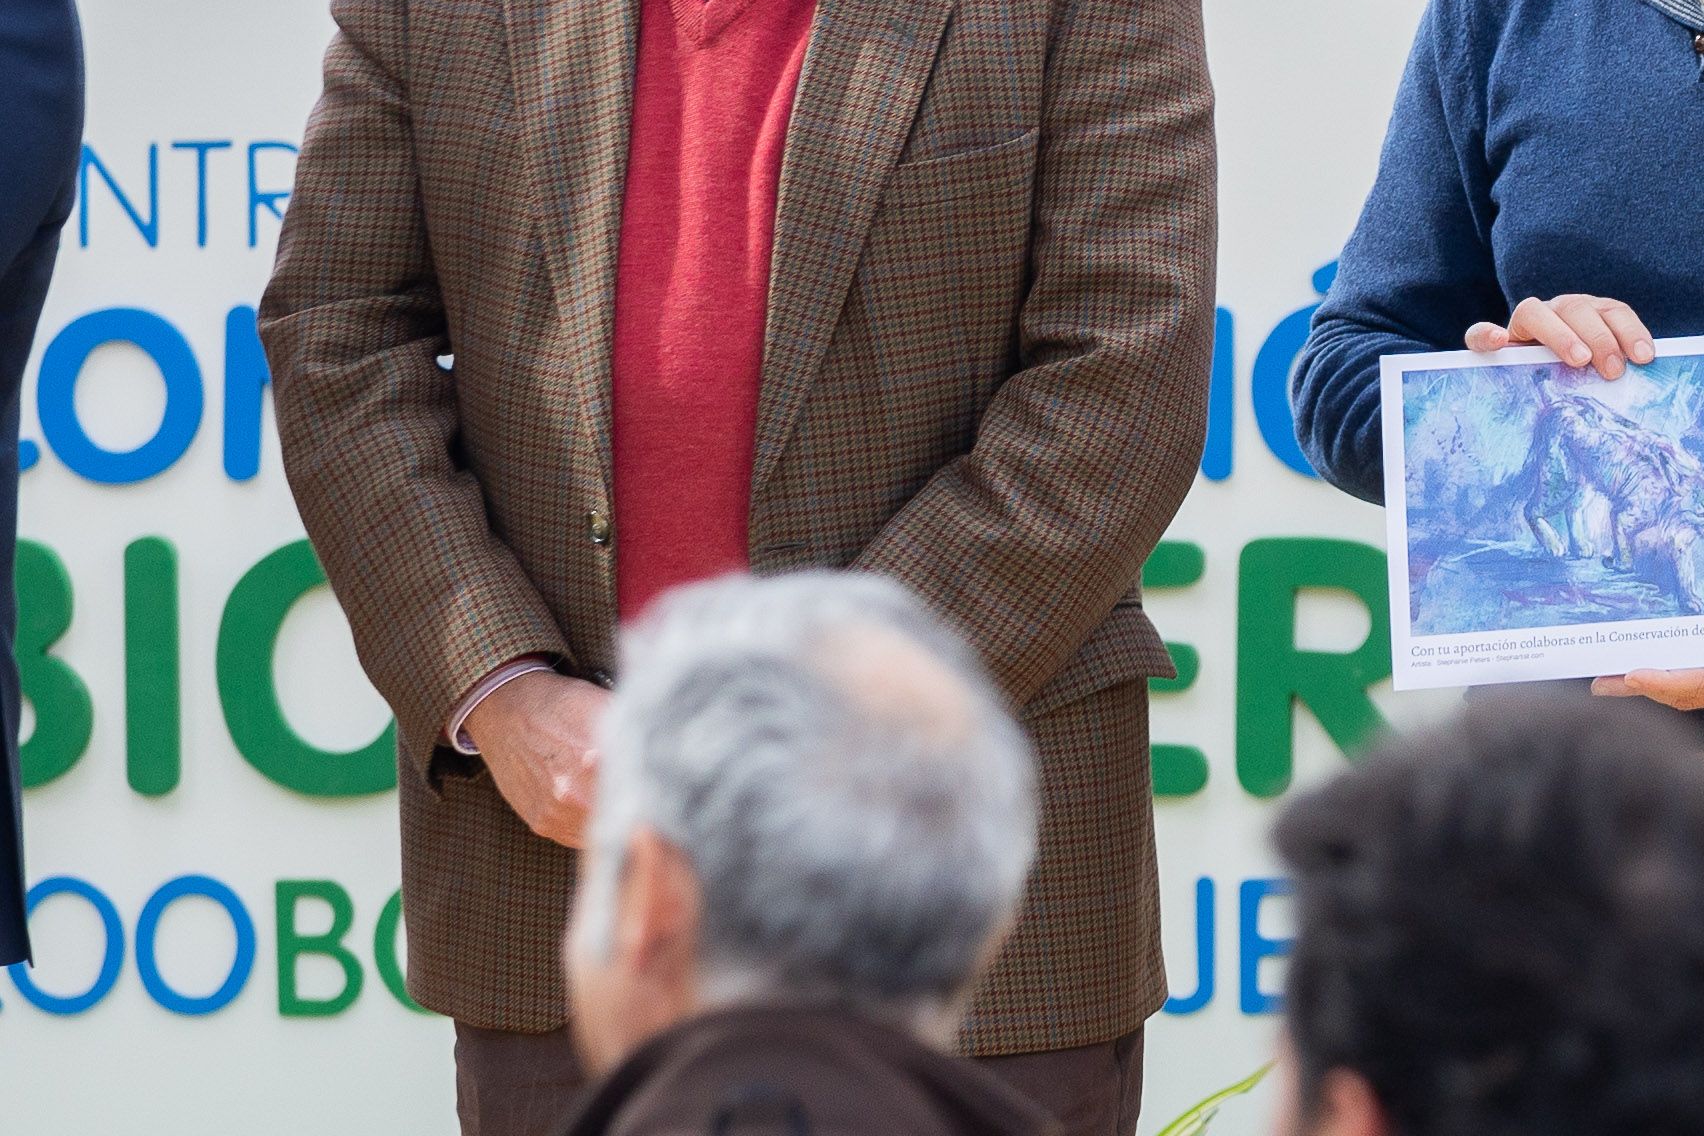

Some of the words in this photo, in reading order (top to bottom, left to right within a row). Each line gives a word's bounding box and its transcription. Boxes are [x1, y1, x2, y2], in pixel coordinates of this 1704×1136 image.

[79, 140, 300, 249] NTR
[1411, 645, 1435, 658] Con
[1438, 645, 1451, 656] tu
[1453, 639, 1517, 657] aportación
[1520, 633, 1576, 649] colaboras
[1578, 635, 1593, 645] en
[1595, 631, 1606, 643] la
[1608, 624, 1689, 643] Conservación
